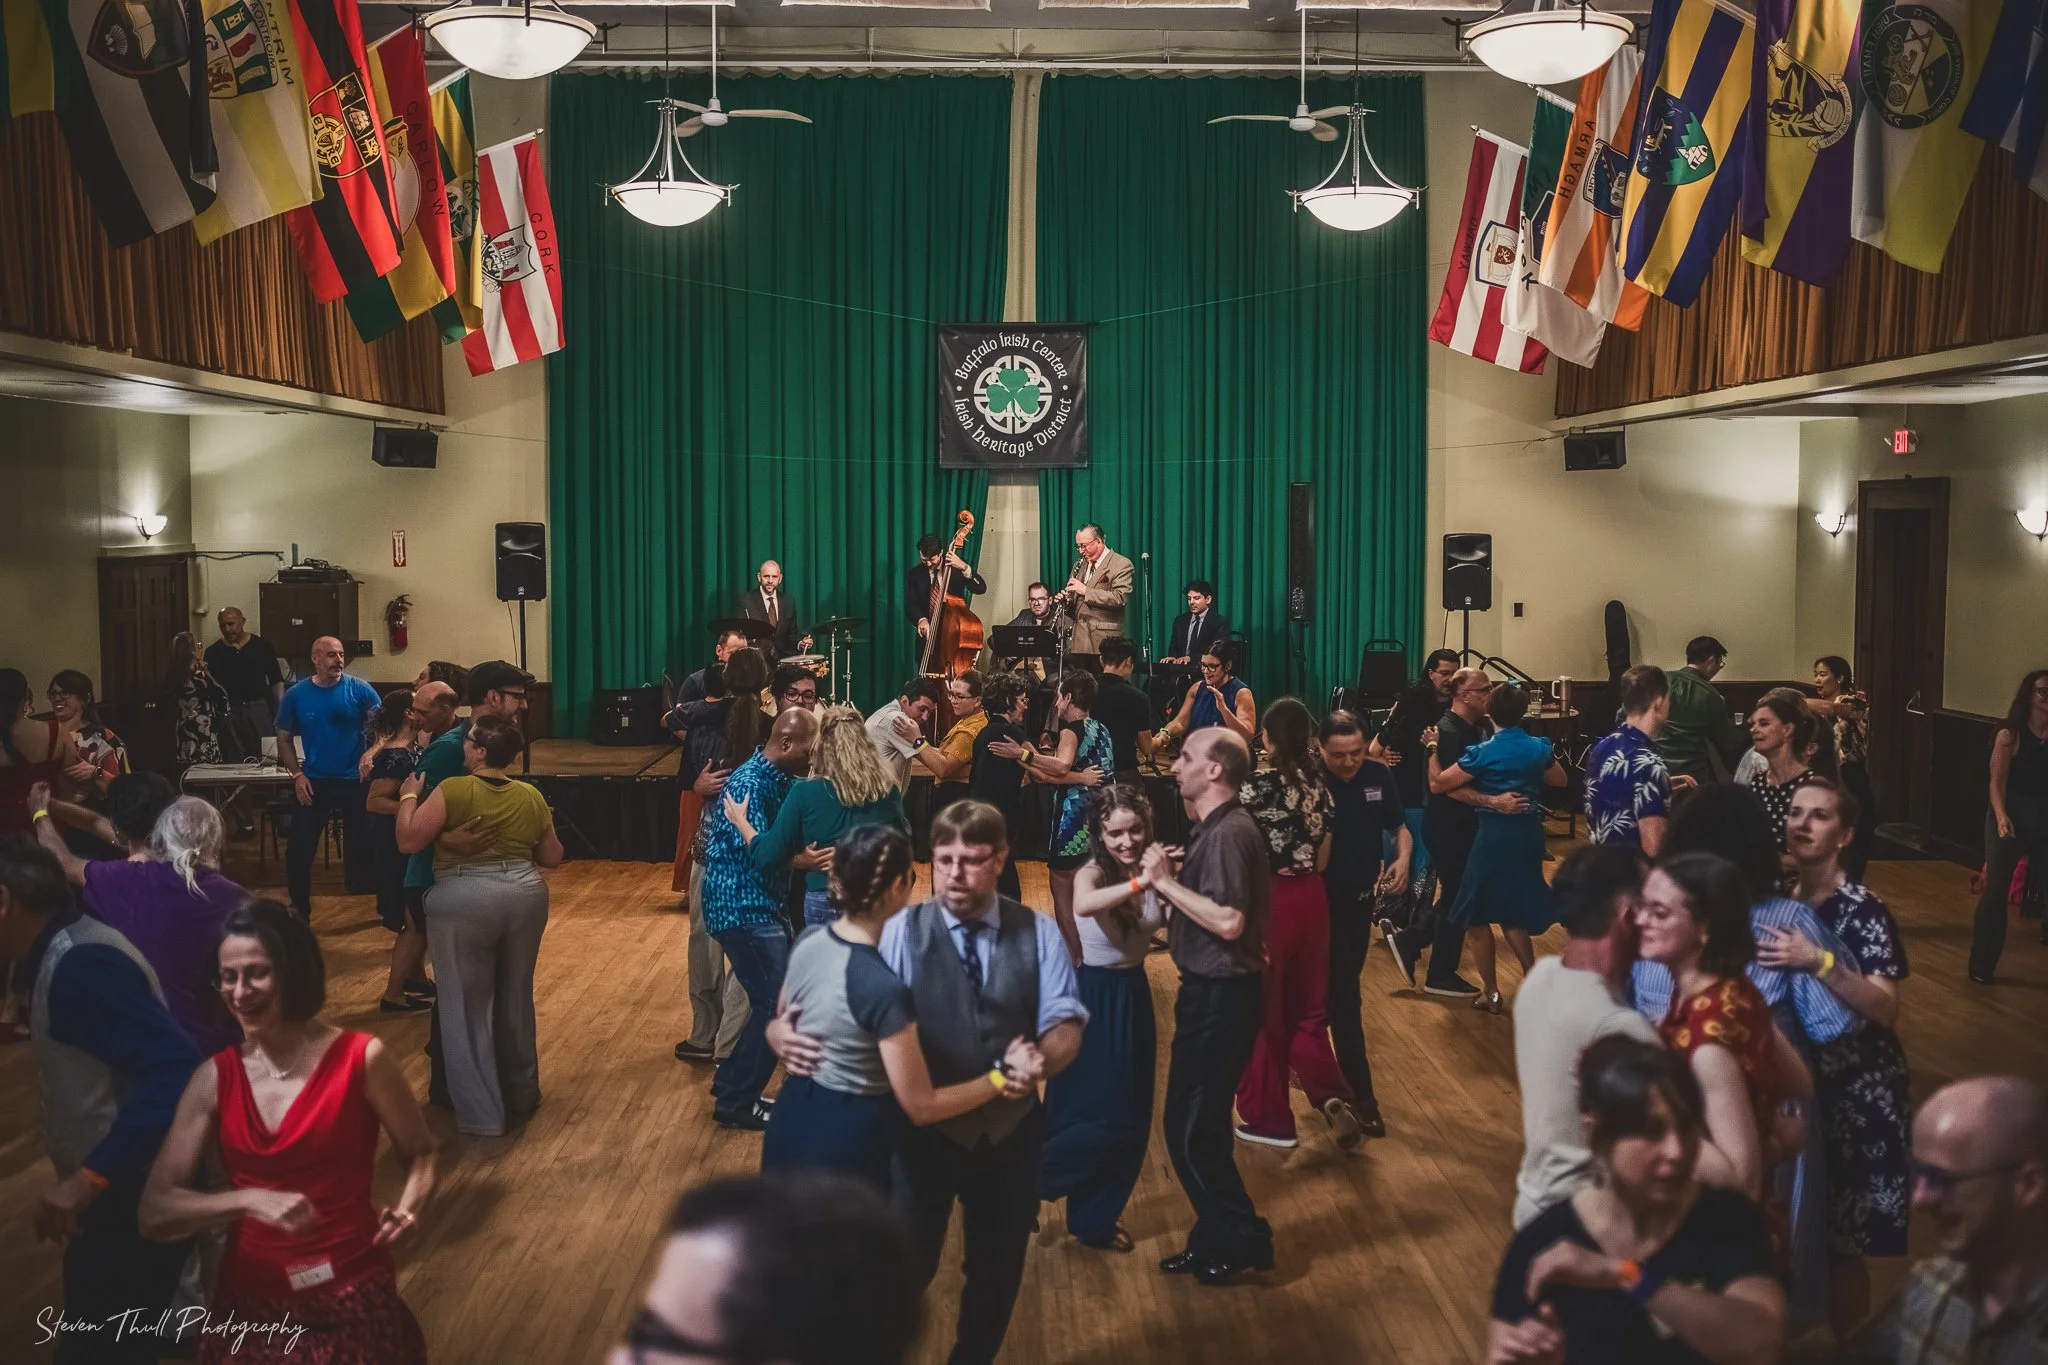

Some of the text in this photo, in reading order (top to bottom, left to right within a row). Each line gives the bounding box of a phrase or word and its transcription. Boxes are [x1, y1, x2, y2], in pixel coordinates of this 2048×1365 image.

[266, 2, 295, 85] NTRIM
[530, 212, 556, 274] CORK
[954, 332, 1068, 380] Buffalo Irish Center
[954, 398, 1072, 458] Irish Heritage District
[1894, 430, 1909, 454] EXIT
